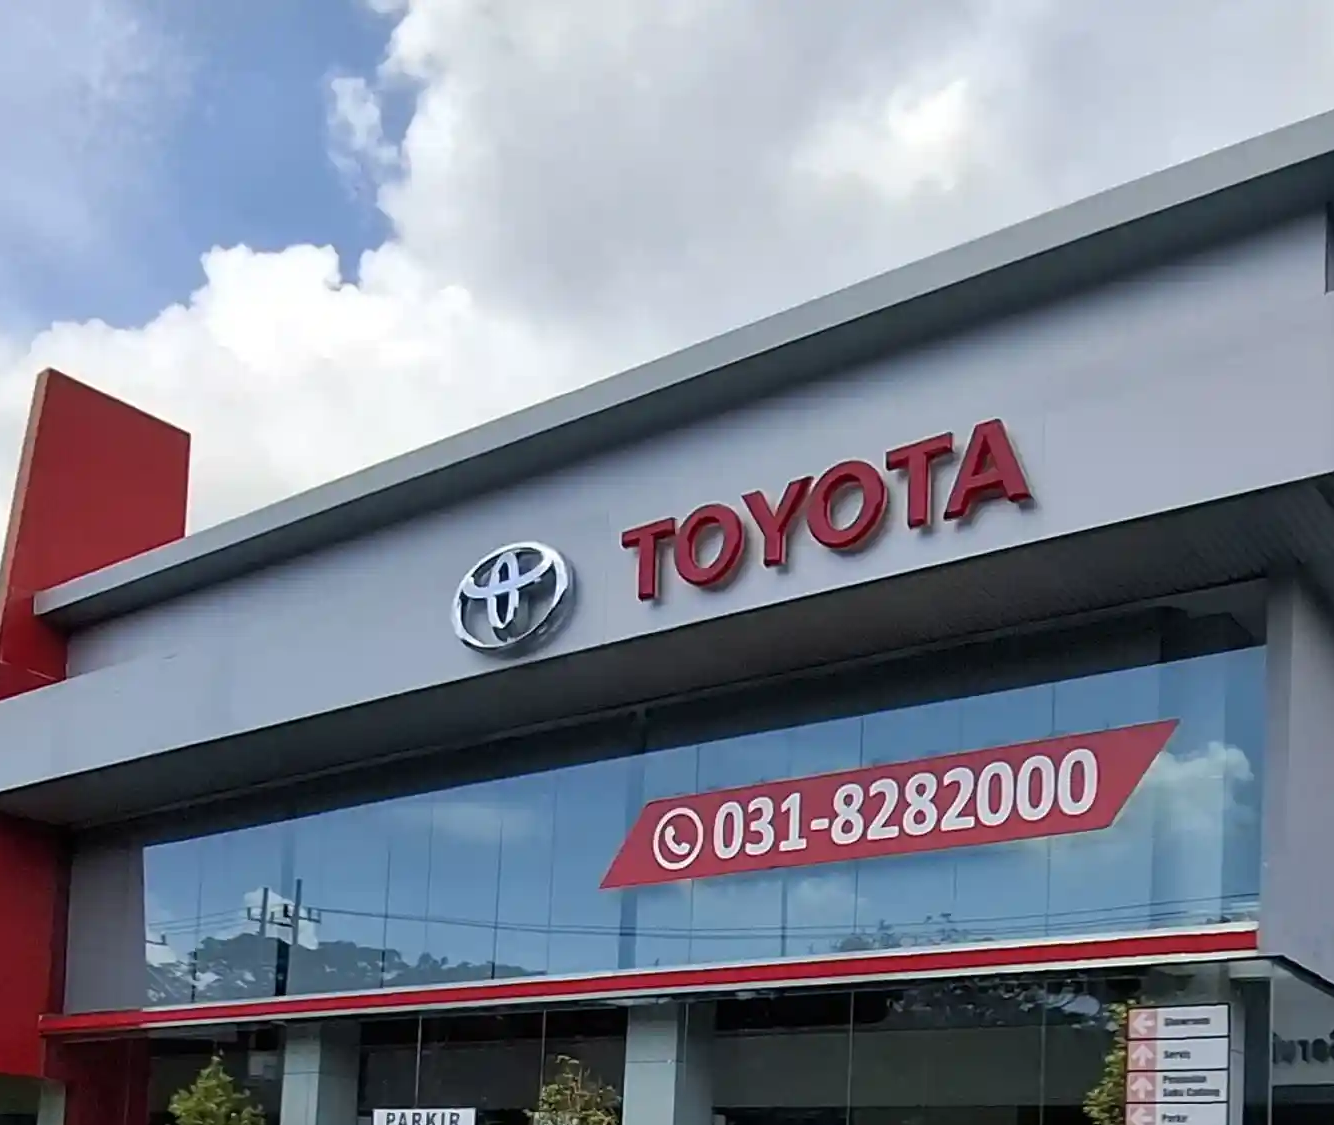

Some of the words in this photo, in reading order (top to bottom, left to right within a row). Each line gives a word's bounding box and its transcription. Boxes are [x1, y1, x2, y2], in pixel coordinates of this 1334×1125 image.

[620, 418, 1033, 601] TOYOTA
[713, 748, 1100, 860] 031-8282000
[1163, 1050, 1191, 1059] Servis
[1161, 1113, 1188, 1123] Parkir
